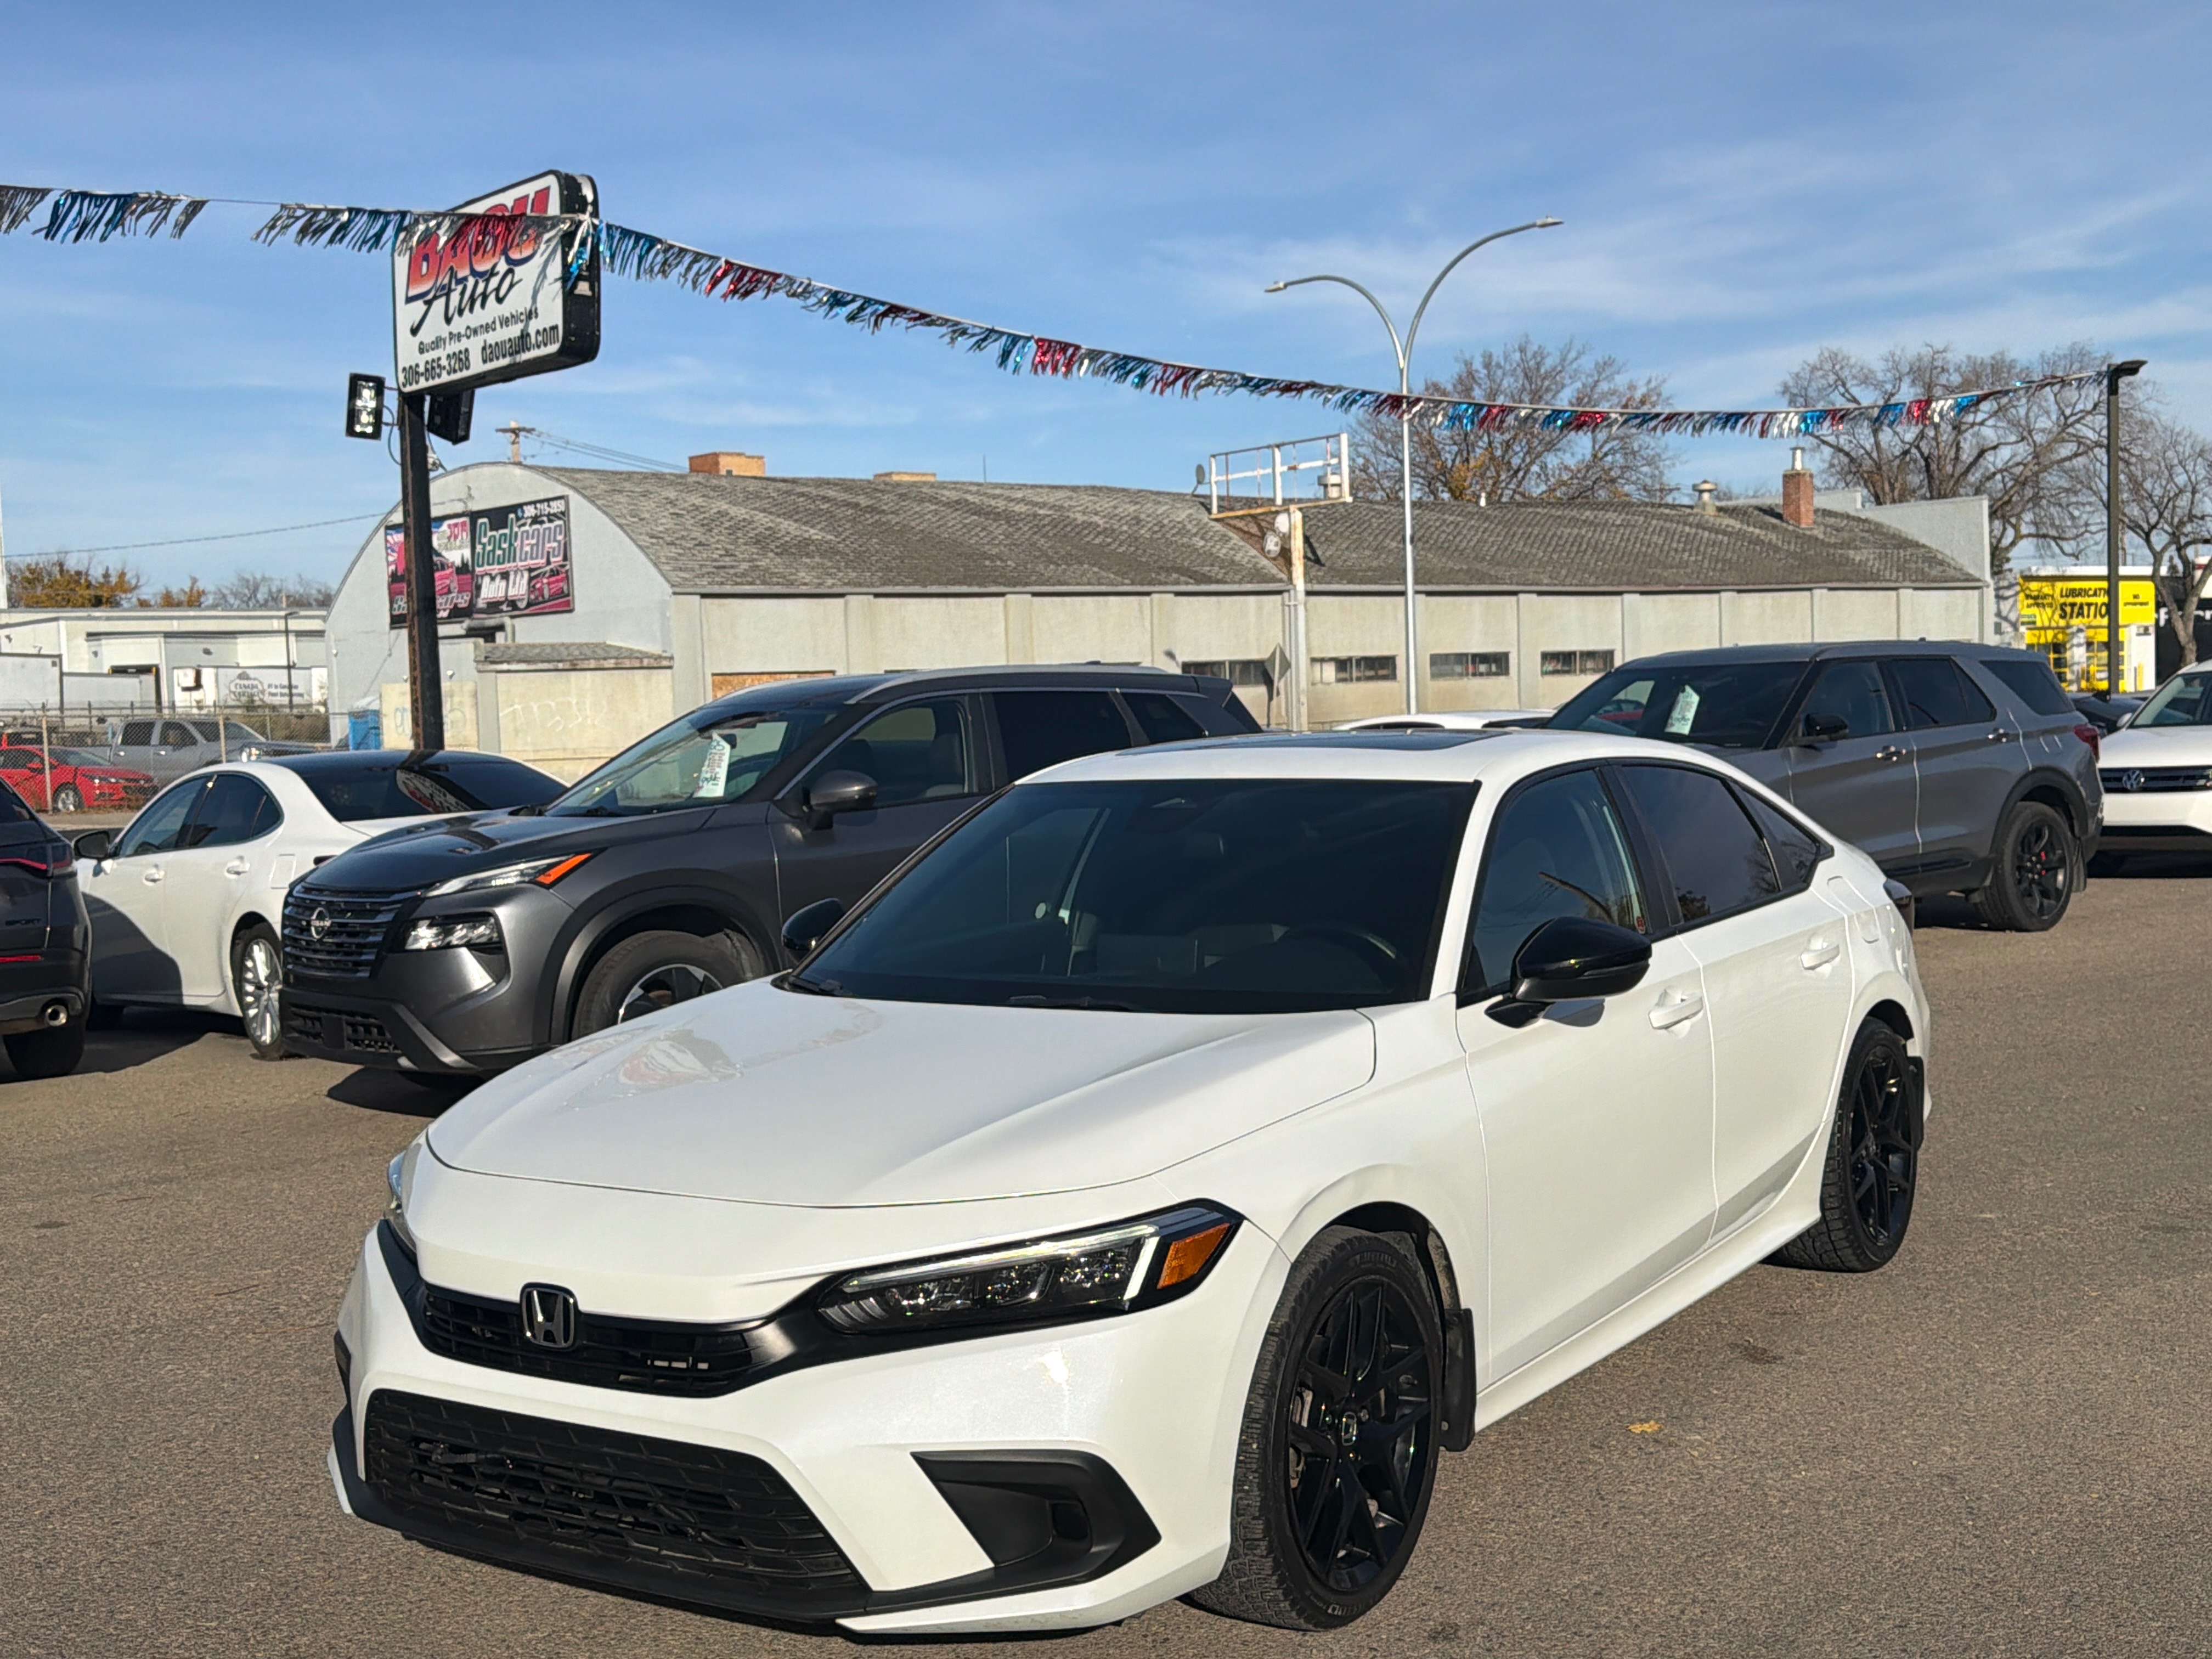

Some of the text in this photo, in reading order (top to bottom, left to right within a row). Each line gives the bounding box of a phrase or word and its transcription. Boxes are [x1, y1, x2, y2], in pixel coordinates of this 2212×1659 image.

[409, 266, 523, 337] Auto
[417, 306, 539, 356] Quality Pre-Owned Vehicles
[401, 323, 560, 388] 306-665-3268 daouauto.com
[480, 576, 507, 602] Auto
[2060, 588, 2109, 599] LUBRICATI
[2058, 602, 2109, 619] STATIO
